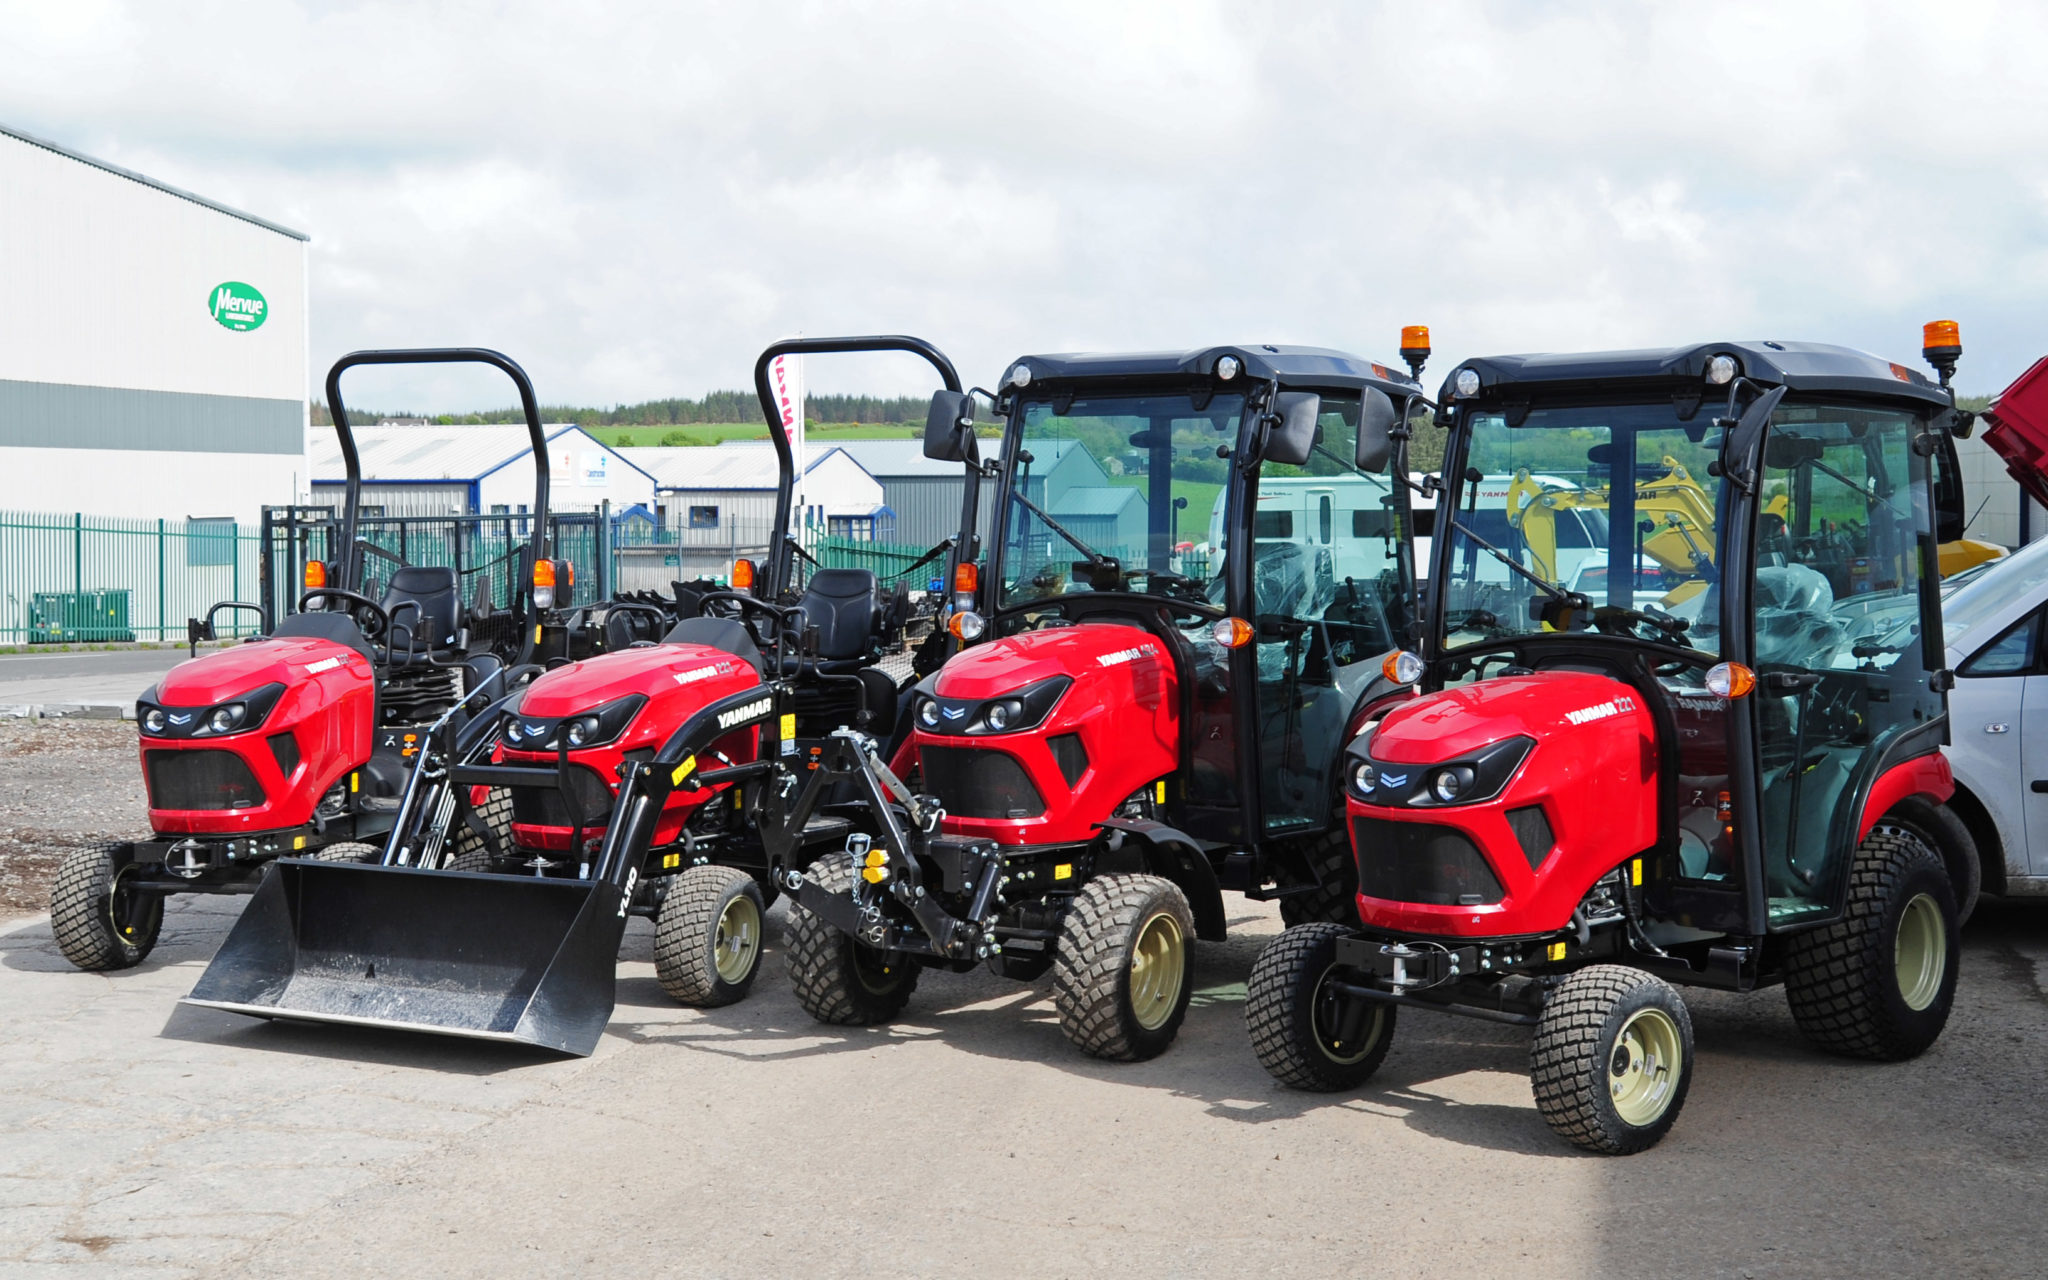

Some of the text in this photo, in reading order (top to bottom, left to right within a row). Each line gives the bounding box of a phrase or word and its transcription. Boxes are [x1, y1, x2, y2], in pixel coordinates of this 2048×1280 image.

[214, 287, 264, 320] Mervue
[1481, 490, 1524, 498] YANMR
[304, 656, 341, 674] YANMAR
[1096, 647, 1142, 667] YANMAR
[673, 665, 719, 685] YANMAR
[717, 697, 773, 730] YANMAR
[1564, 696, 1637, 726] YANMAR 221
